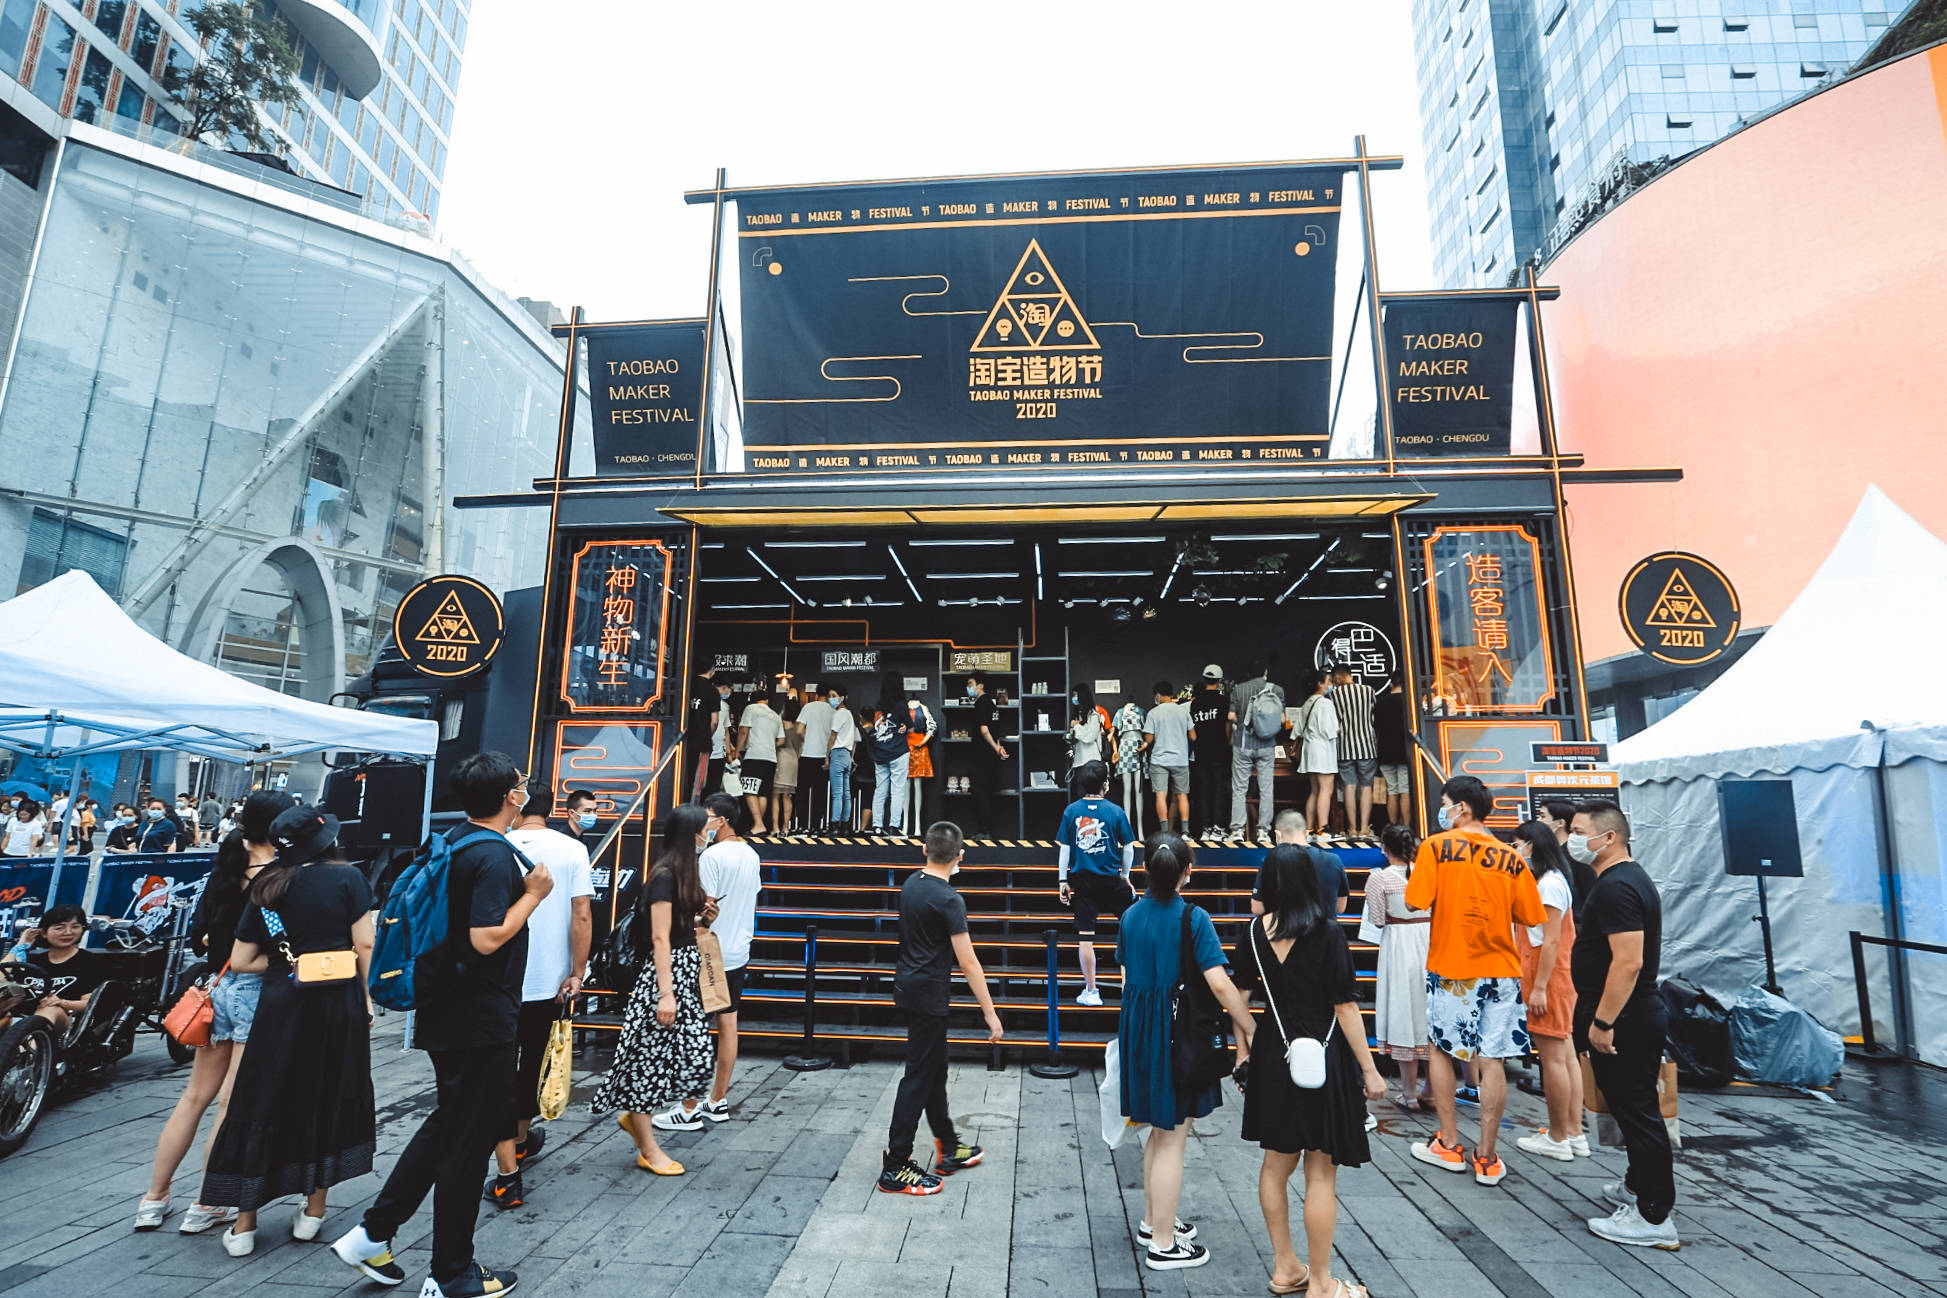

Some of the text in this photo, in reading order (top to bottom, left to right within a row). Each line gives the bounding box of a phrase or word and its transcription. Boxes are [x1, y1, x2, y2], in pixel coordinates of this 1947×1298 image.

[746, 213, 782, 226] TAOBAO
[808, 210, 842, 222] MAKER
[868, 206, 912, 218] FESTIVAL
[939, 204, 976, 216] TAOBAO
[1003, 202, 1038, 212] MAKER
[1066, 198, 1110, 210] FESTIVAL
[1138, 196, 1176, 207] TAOBAO
[1204, 193, 1240, 204] MAKER
[1268, 190, 1314, 202] FESTIVAL
[1019, 302, 1050, 326] 淘
[1402, 332, 1483, 350] TAOBAO
[606, 359, 679, 376] TAOBAO
[969, 355, 1102, 387] 淘宝造物节
[1400, 360, 1468, 376] MAKER
[608, 384, 672, 400] MAKER
[969, 388, 1102, 402] TAOBAO MAKER FESTIVAL
[1397, 384, 1490, 402] FESTIVAL
[611, 408, 694, 424] FESTIVAL
[1016, 402, 1056, 418] 2020
[1394, 434, 1490, 444] TAOBAO CHENGDU
[614, 454, 649, 464] TAOBAO
[753, 458, 790, 468] TAOBAO
[816, 456, 850, 467] MAKER
[876, 455, 920, 466] FESTIVAL
[946, 454, 982, 465] TAOBAO
[1008, 453, 1042, 464] MAKER
[1068, 452, 1112, 462] FESTIVAL
[1136, 450, 1173, 461] TAOBAO
[1199, 449, 1232, 460] MAKER
[1260, 448, 1304, 459] FESTIVAL
[596, 565, 636, 685] 神物新生
[1466, 553, 1513, 682] 造客请入
[1660, 629, 1704, 648] 2020
[426, 644, 468, 662] 2020
[824, 652, 877, 666] 国风潮都
[954, 652, 1008, 664] 宠萌圣地
